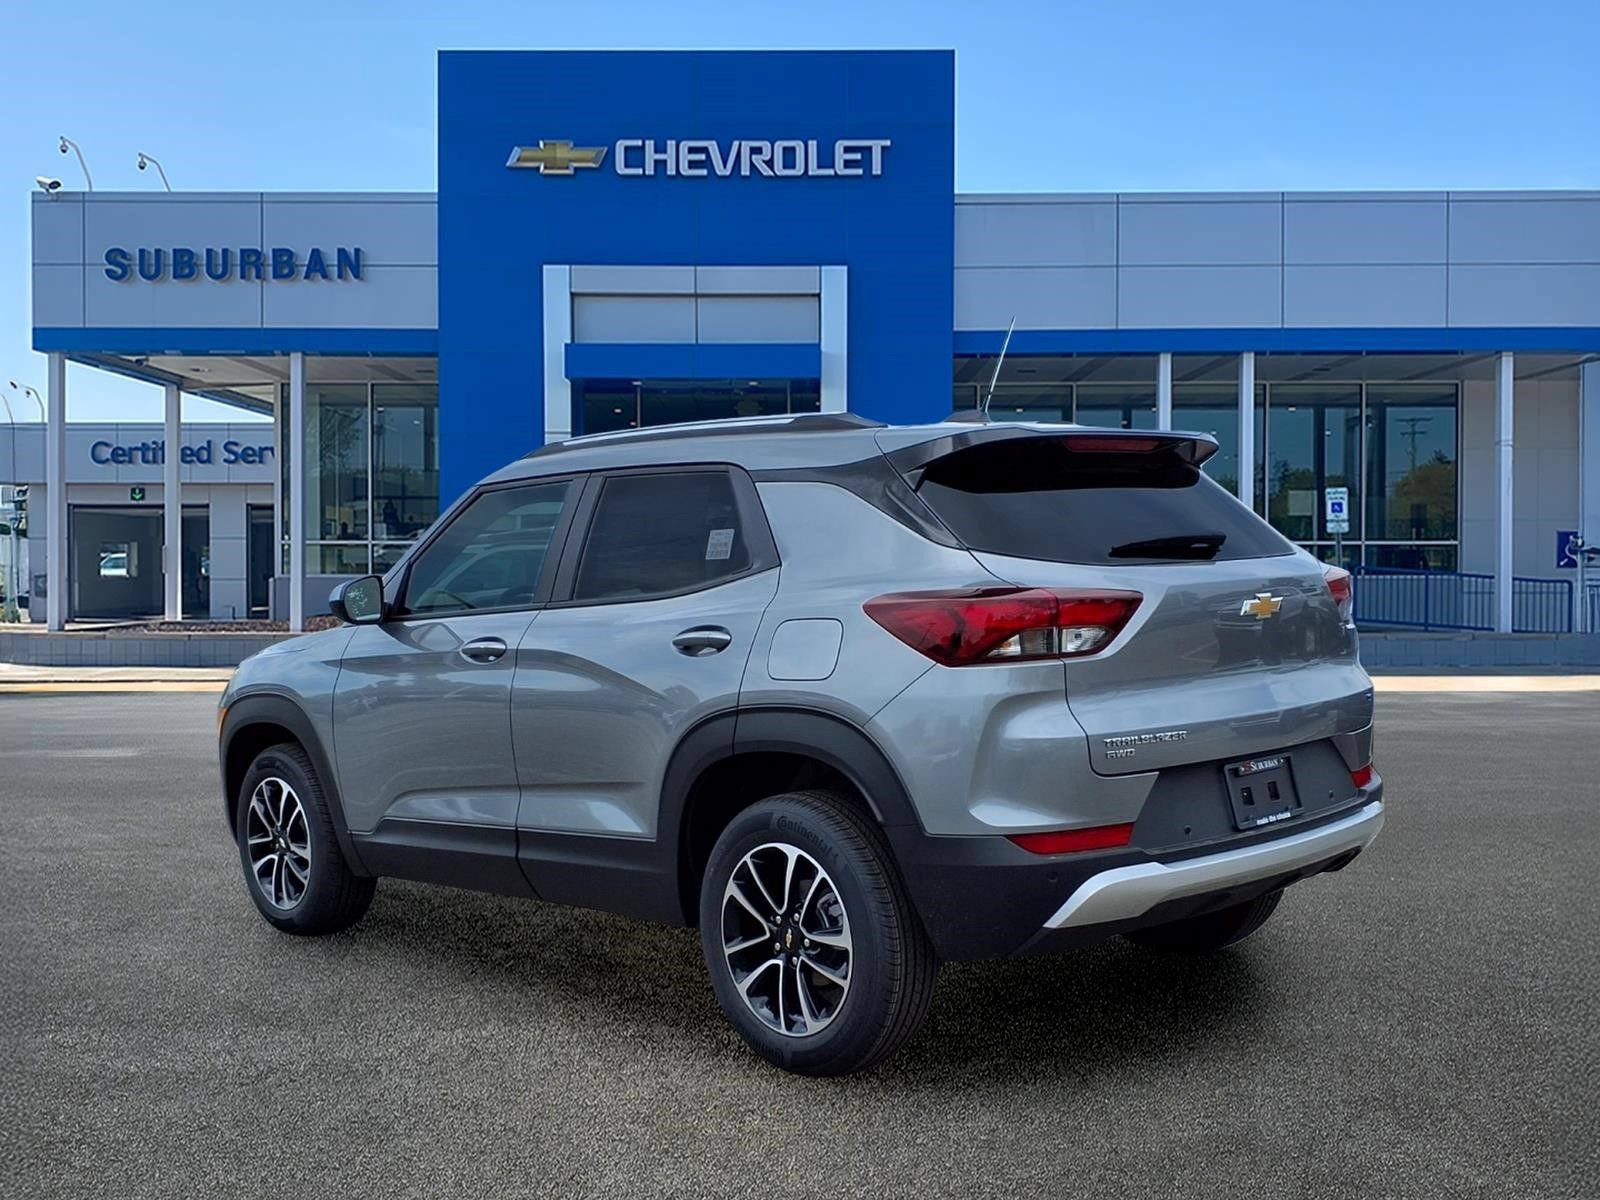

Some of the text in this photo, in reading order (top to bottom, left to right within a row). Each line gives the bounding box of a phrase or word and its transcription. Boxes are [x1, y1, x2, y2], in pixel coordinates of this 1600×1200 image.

[615, 139, 891, 176] CHEVROLET
[104, 247, 363, 282] SUBURBAN
[90, 440, 212, 465] Certifed
[1104, 730, 1188, 748] TRAILBLAZER
[1106, 748, 1136, 760] AWD
[776, 815, 834, 857] Continental
